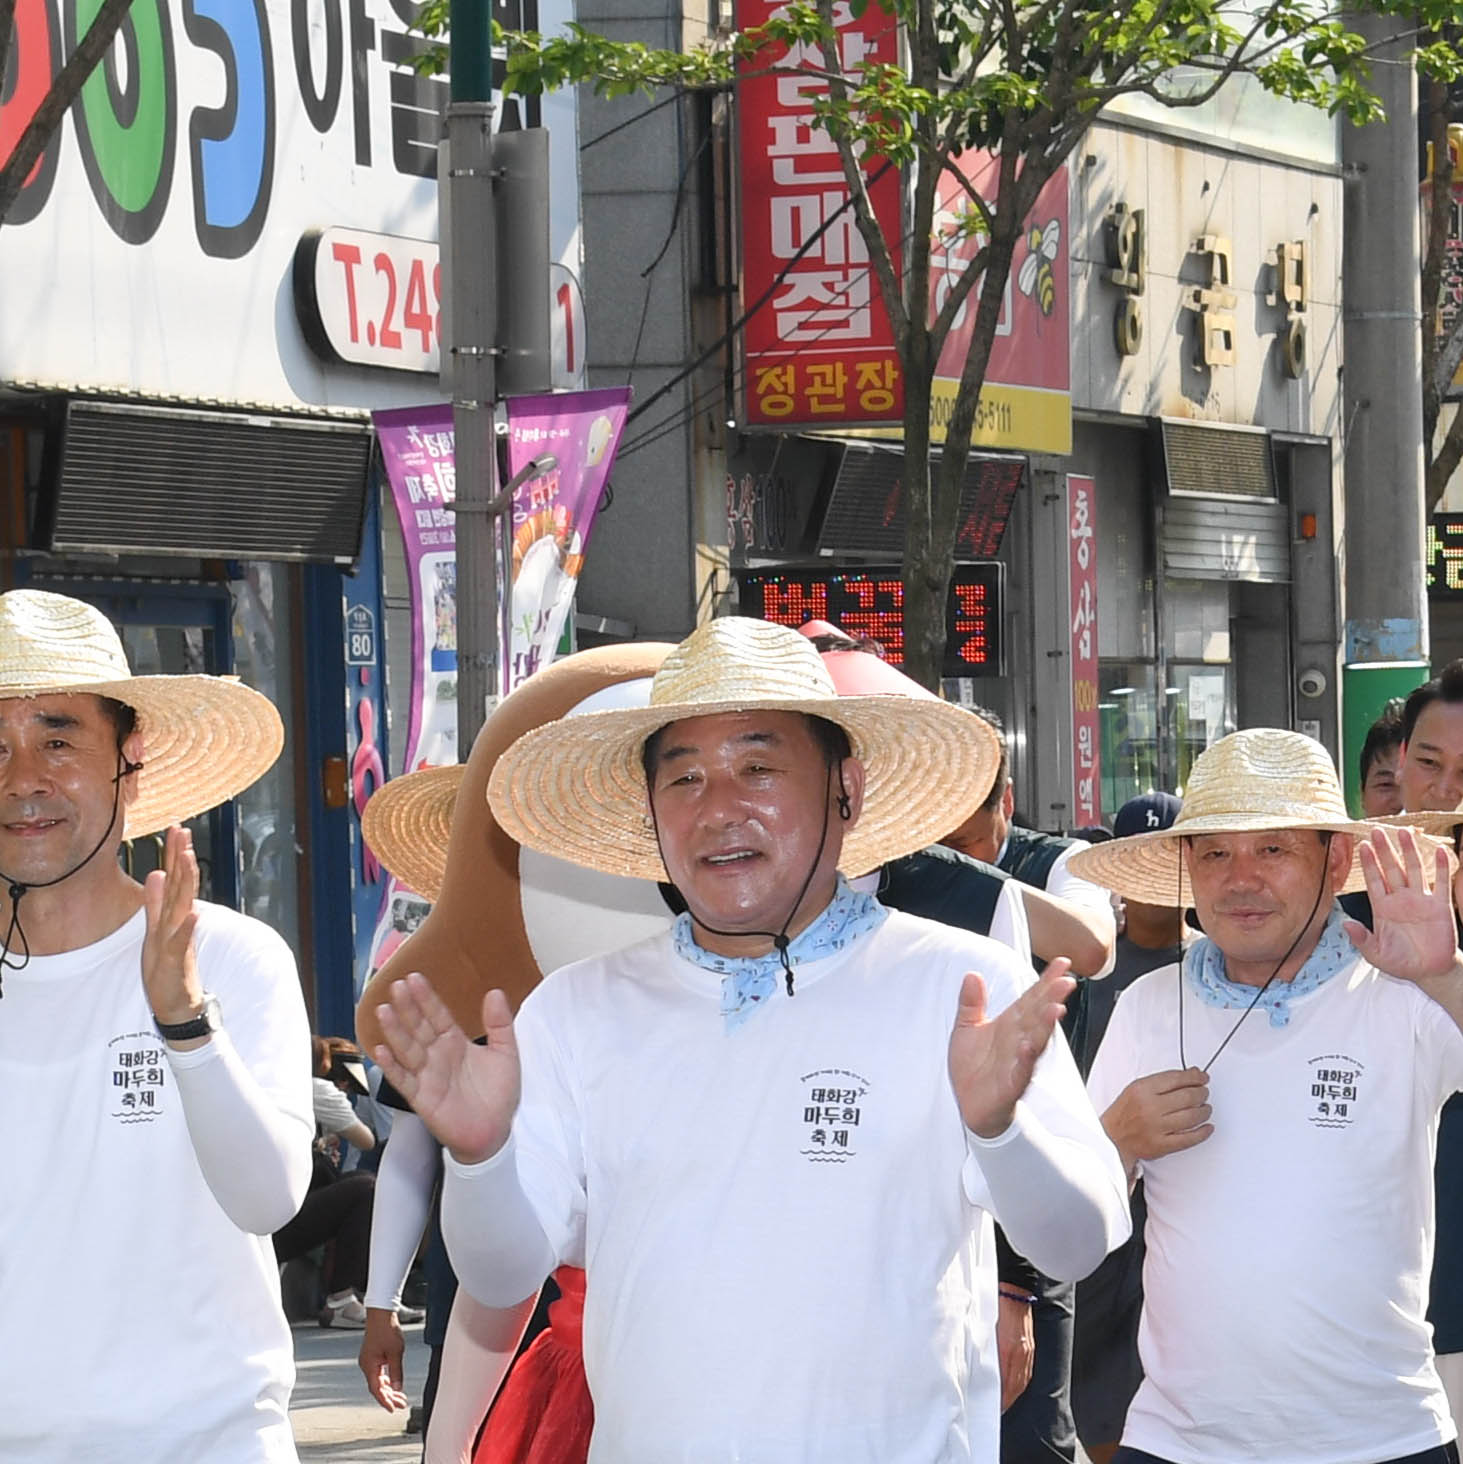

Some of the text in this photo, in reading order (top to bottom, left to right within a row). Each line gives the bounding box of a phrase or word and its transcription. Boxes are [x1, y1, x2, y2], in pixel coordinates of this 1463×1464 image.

[755, 360, 899, 416] 정관장
[1071, 489, 1094, 662] 홍삼
[352, 634, 371, 656] 80
[1079, 725, 1094, 820] 원액
[119, 1050, 159, 1068] 태화강
[113, 1068, 164, 1089] 마두희
[1317, 1069, 1354, 1084] 태화강
[121, 1091, 155, 1108] 축제
[811, 1088, 857, 1105] 태화강
[1311, 1084, 1357, 1102] 마두희
[804, 1106, 860, 1126] 마두희
[1318, 1102, 1347, 1116] 축제
[811, 1129, 848, 1147] 축제
